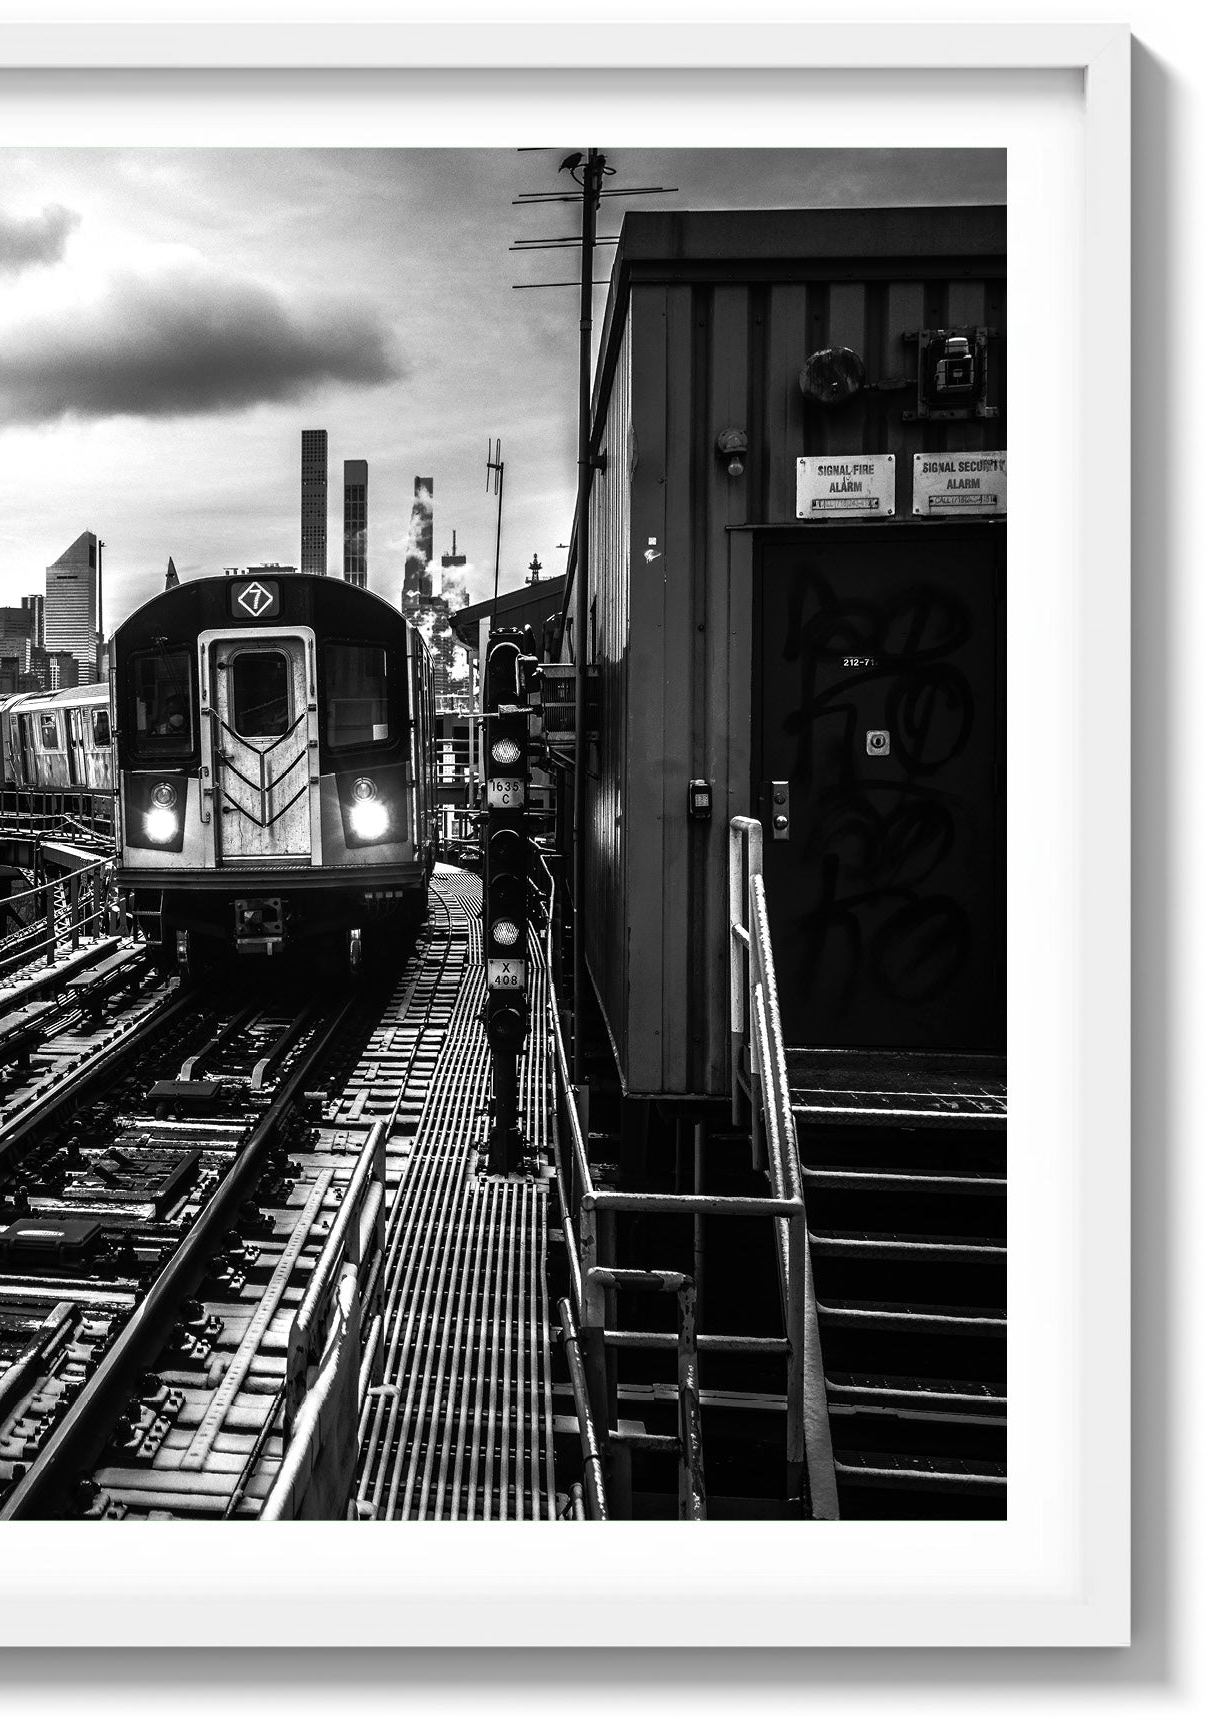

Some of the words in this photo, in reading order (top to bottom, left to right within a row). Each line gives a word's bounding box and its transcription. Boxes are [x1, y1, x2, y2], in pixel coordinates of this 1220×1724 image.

[817, 465, 850, 476] SIGNAL
[853, 464, 875, 475] FIRE
[922, 462, 956, 473] SIGNAL
[829, 481, 863, 493] ALARM
[946, 478, 981, 489] ALARM
[249, 589, 261, 609] 7
[492, 781, 520, 792] 1635
[502, 794, 510, 804] C
[501, 963, 511, 973] X
[495, 975, 518, 986] 408
